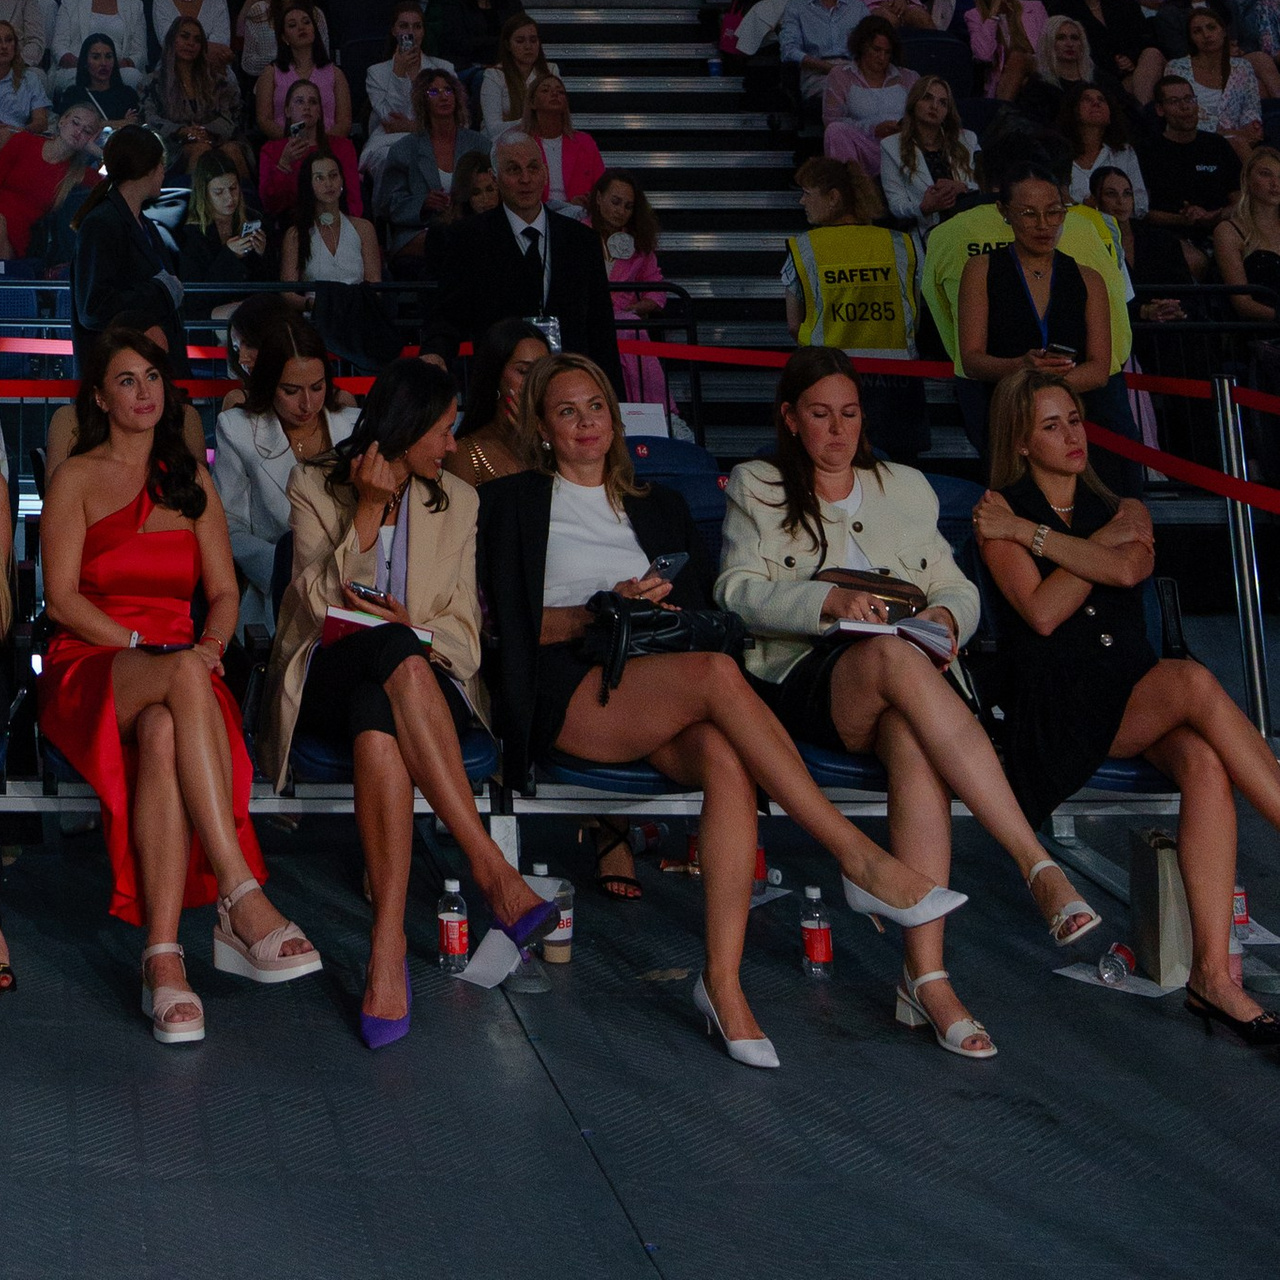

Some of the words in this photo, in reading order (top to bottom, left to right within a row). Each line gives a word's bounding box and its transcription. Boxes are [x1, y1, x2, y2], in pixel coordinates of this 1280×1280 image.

[825, 268, 891, 285] SAFETY
[831, 301, 896, 323] K0285
[637, 445, 649, 455] 14
